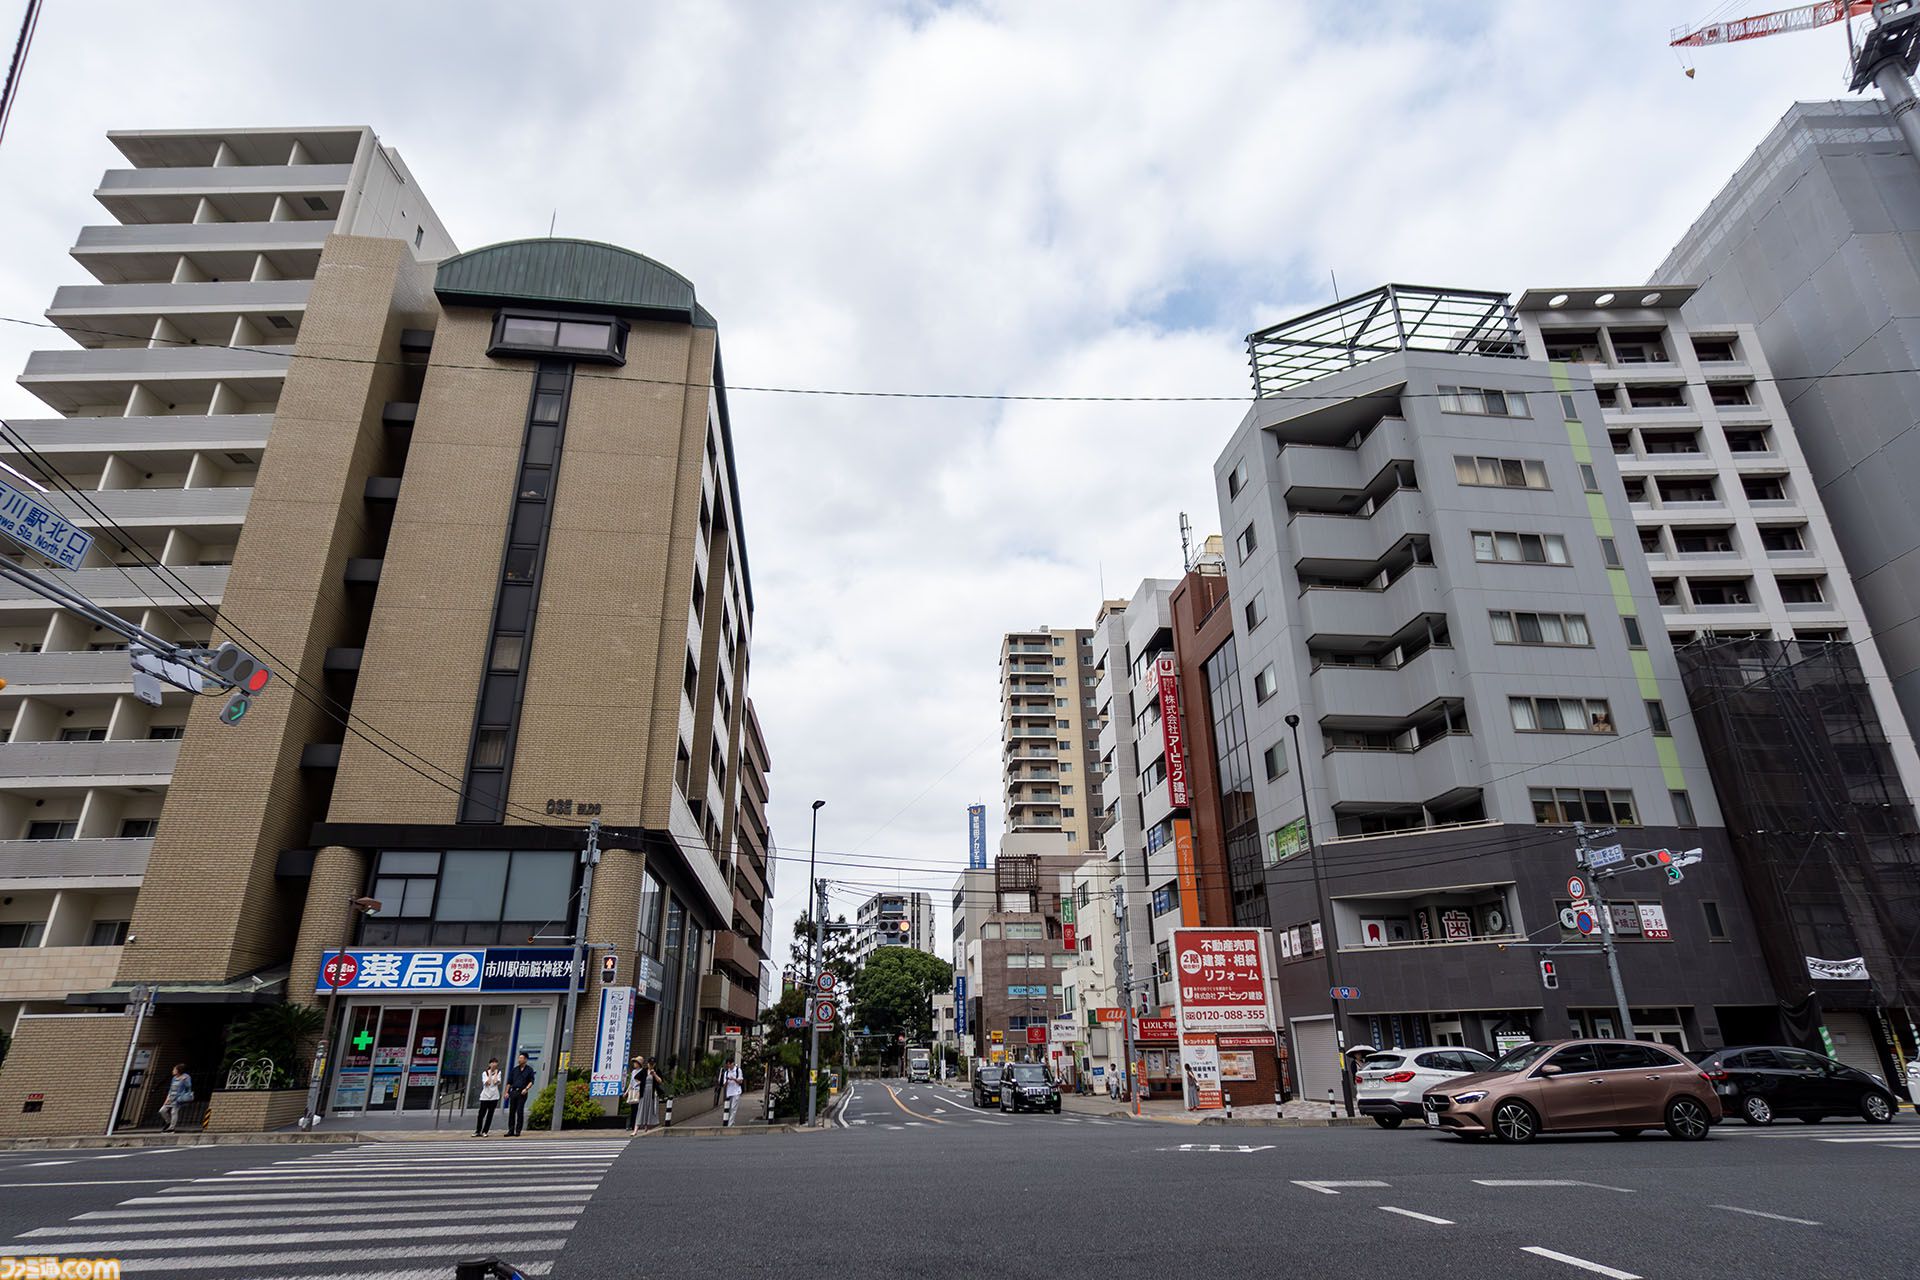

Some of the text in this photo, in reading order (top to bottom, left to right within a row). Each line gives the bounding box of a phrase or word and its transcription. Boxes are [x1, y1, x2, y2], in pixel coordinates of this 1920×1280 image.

[35, 535, 59, 555] North
[1164, 694, 1187, 804] 株式会社アービック建設
[1572, 885, 1581, 894] 40
[1443, 910, 1472, 942] 歯
[1200, 939, 1256, 952] 不動産売買
[1202, 953, 1258, 967] 建築・相続
[357, 953, 443, 987] 薬局
[452, 969, 470, 983] 8分
[1204, 969, 1260, 982] リフォーム
[821, 977, 831, 987] 30
[1106, 1010, 1127, 1020] au
[1195, 1010, 1265, 1021] 0120-088-355
[591, 1082, 619, 1096] 薬局
